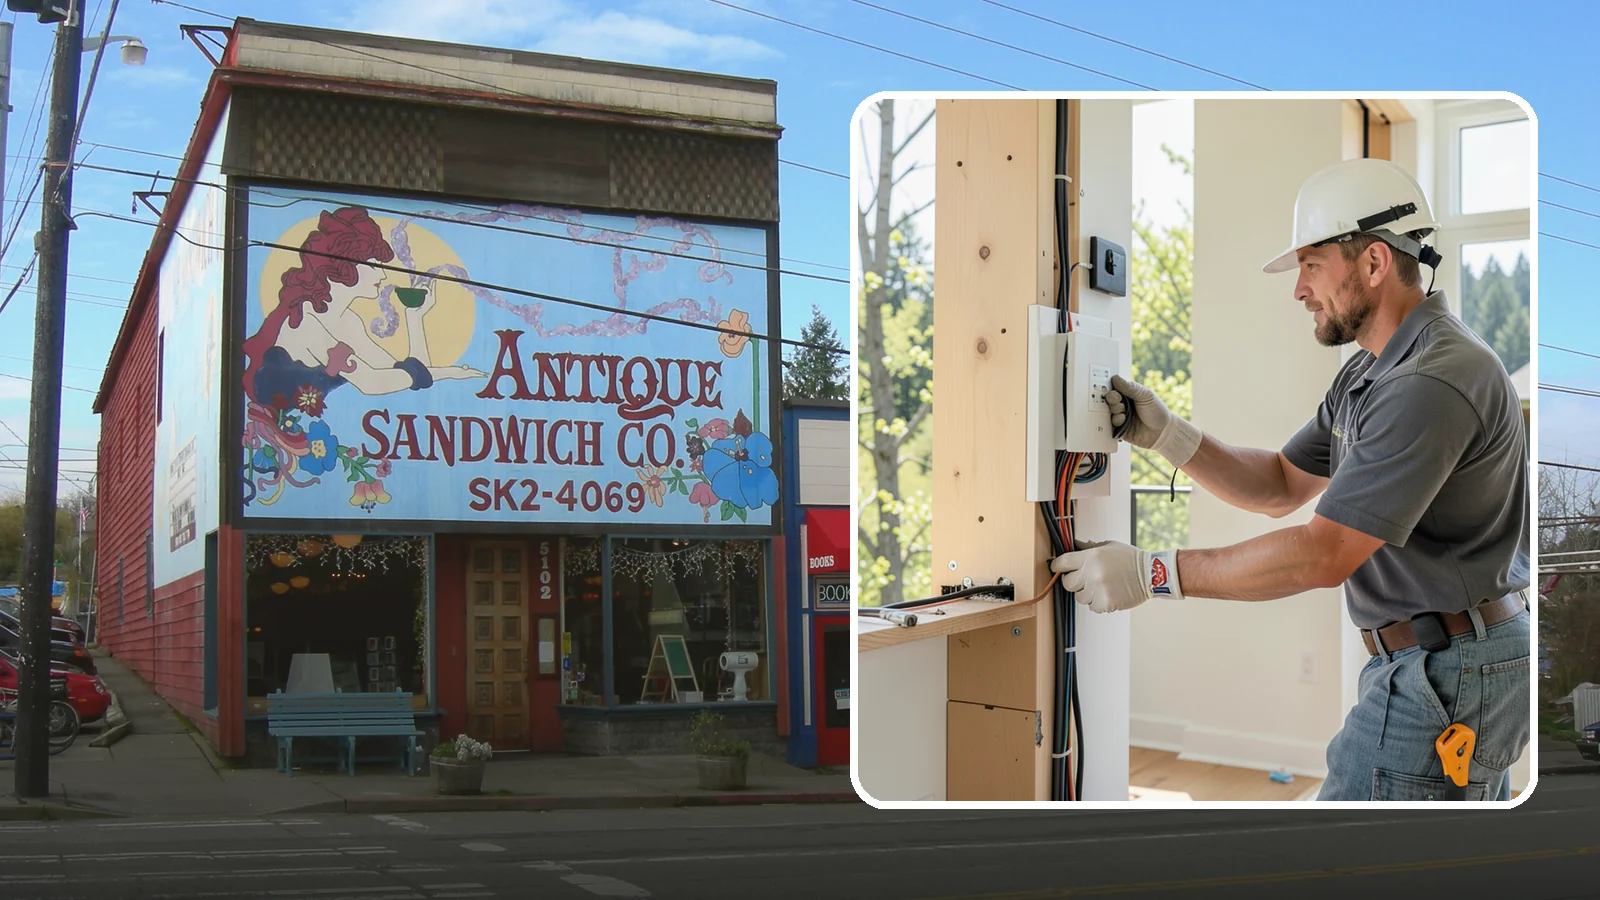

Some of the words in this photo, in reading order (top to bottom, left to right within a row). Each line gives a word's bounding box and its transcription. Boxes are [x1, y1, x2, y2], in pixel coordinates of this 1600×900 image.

[475, 329, 724, 420] ANTIQUE
[361, 409, 604, 467] SANDWICH
[617, 422, 684, 468] CO.
[469, 477, 645, 513] SK2-4069
[540, 542, 552, 599] 5102
[809, 556, 834, 568] BOOKS
